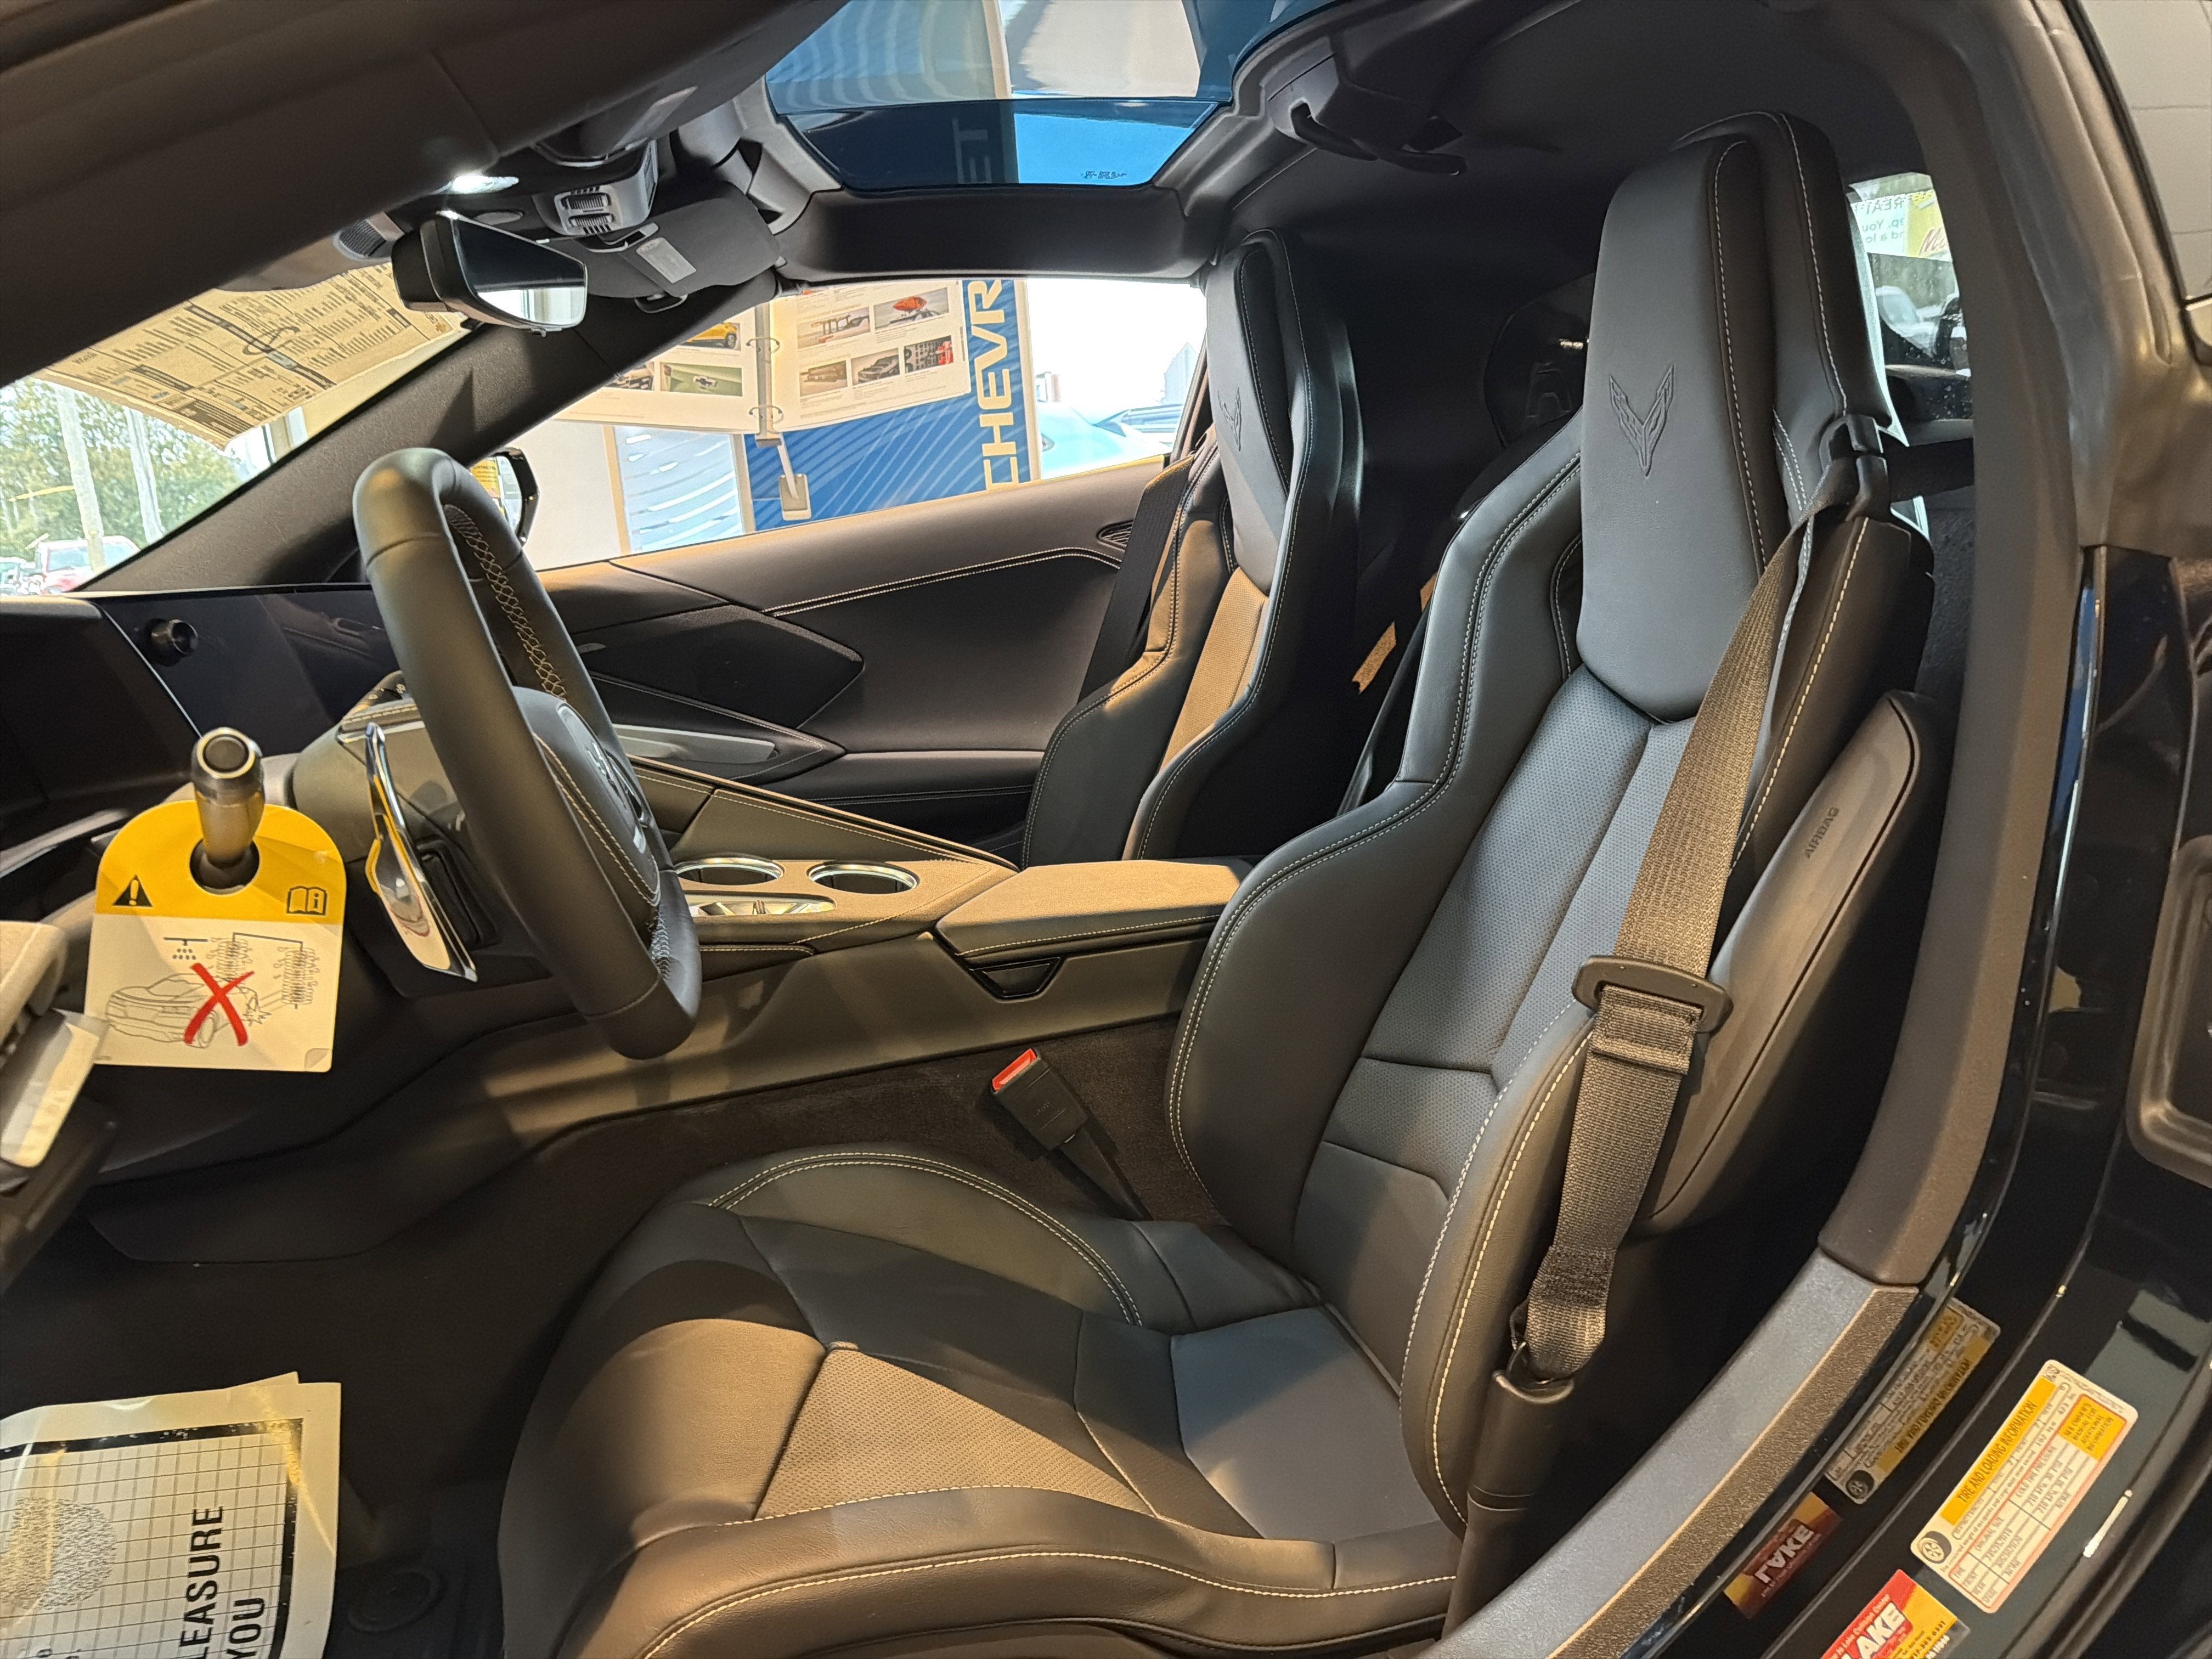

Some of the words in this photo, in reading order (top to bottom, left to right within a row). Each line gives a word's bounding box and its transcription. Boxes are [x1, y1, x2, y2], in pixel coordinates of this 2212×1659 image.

[1804, 807, 1839, 859] AIRBAG
[1956, 1484, 1976, 1504] TIRE
[1967, 1470, 1987, 1489] AND
[1977, 1441, 2007, 1475] LOADING
[1998, 1400, 2038, 1446] INFORMATION
[226, 1598, 264, 1659] YOU
